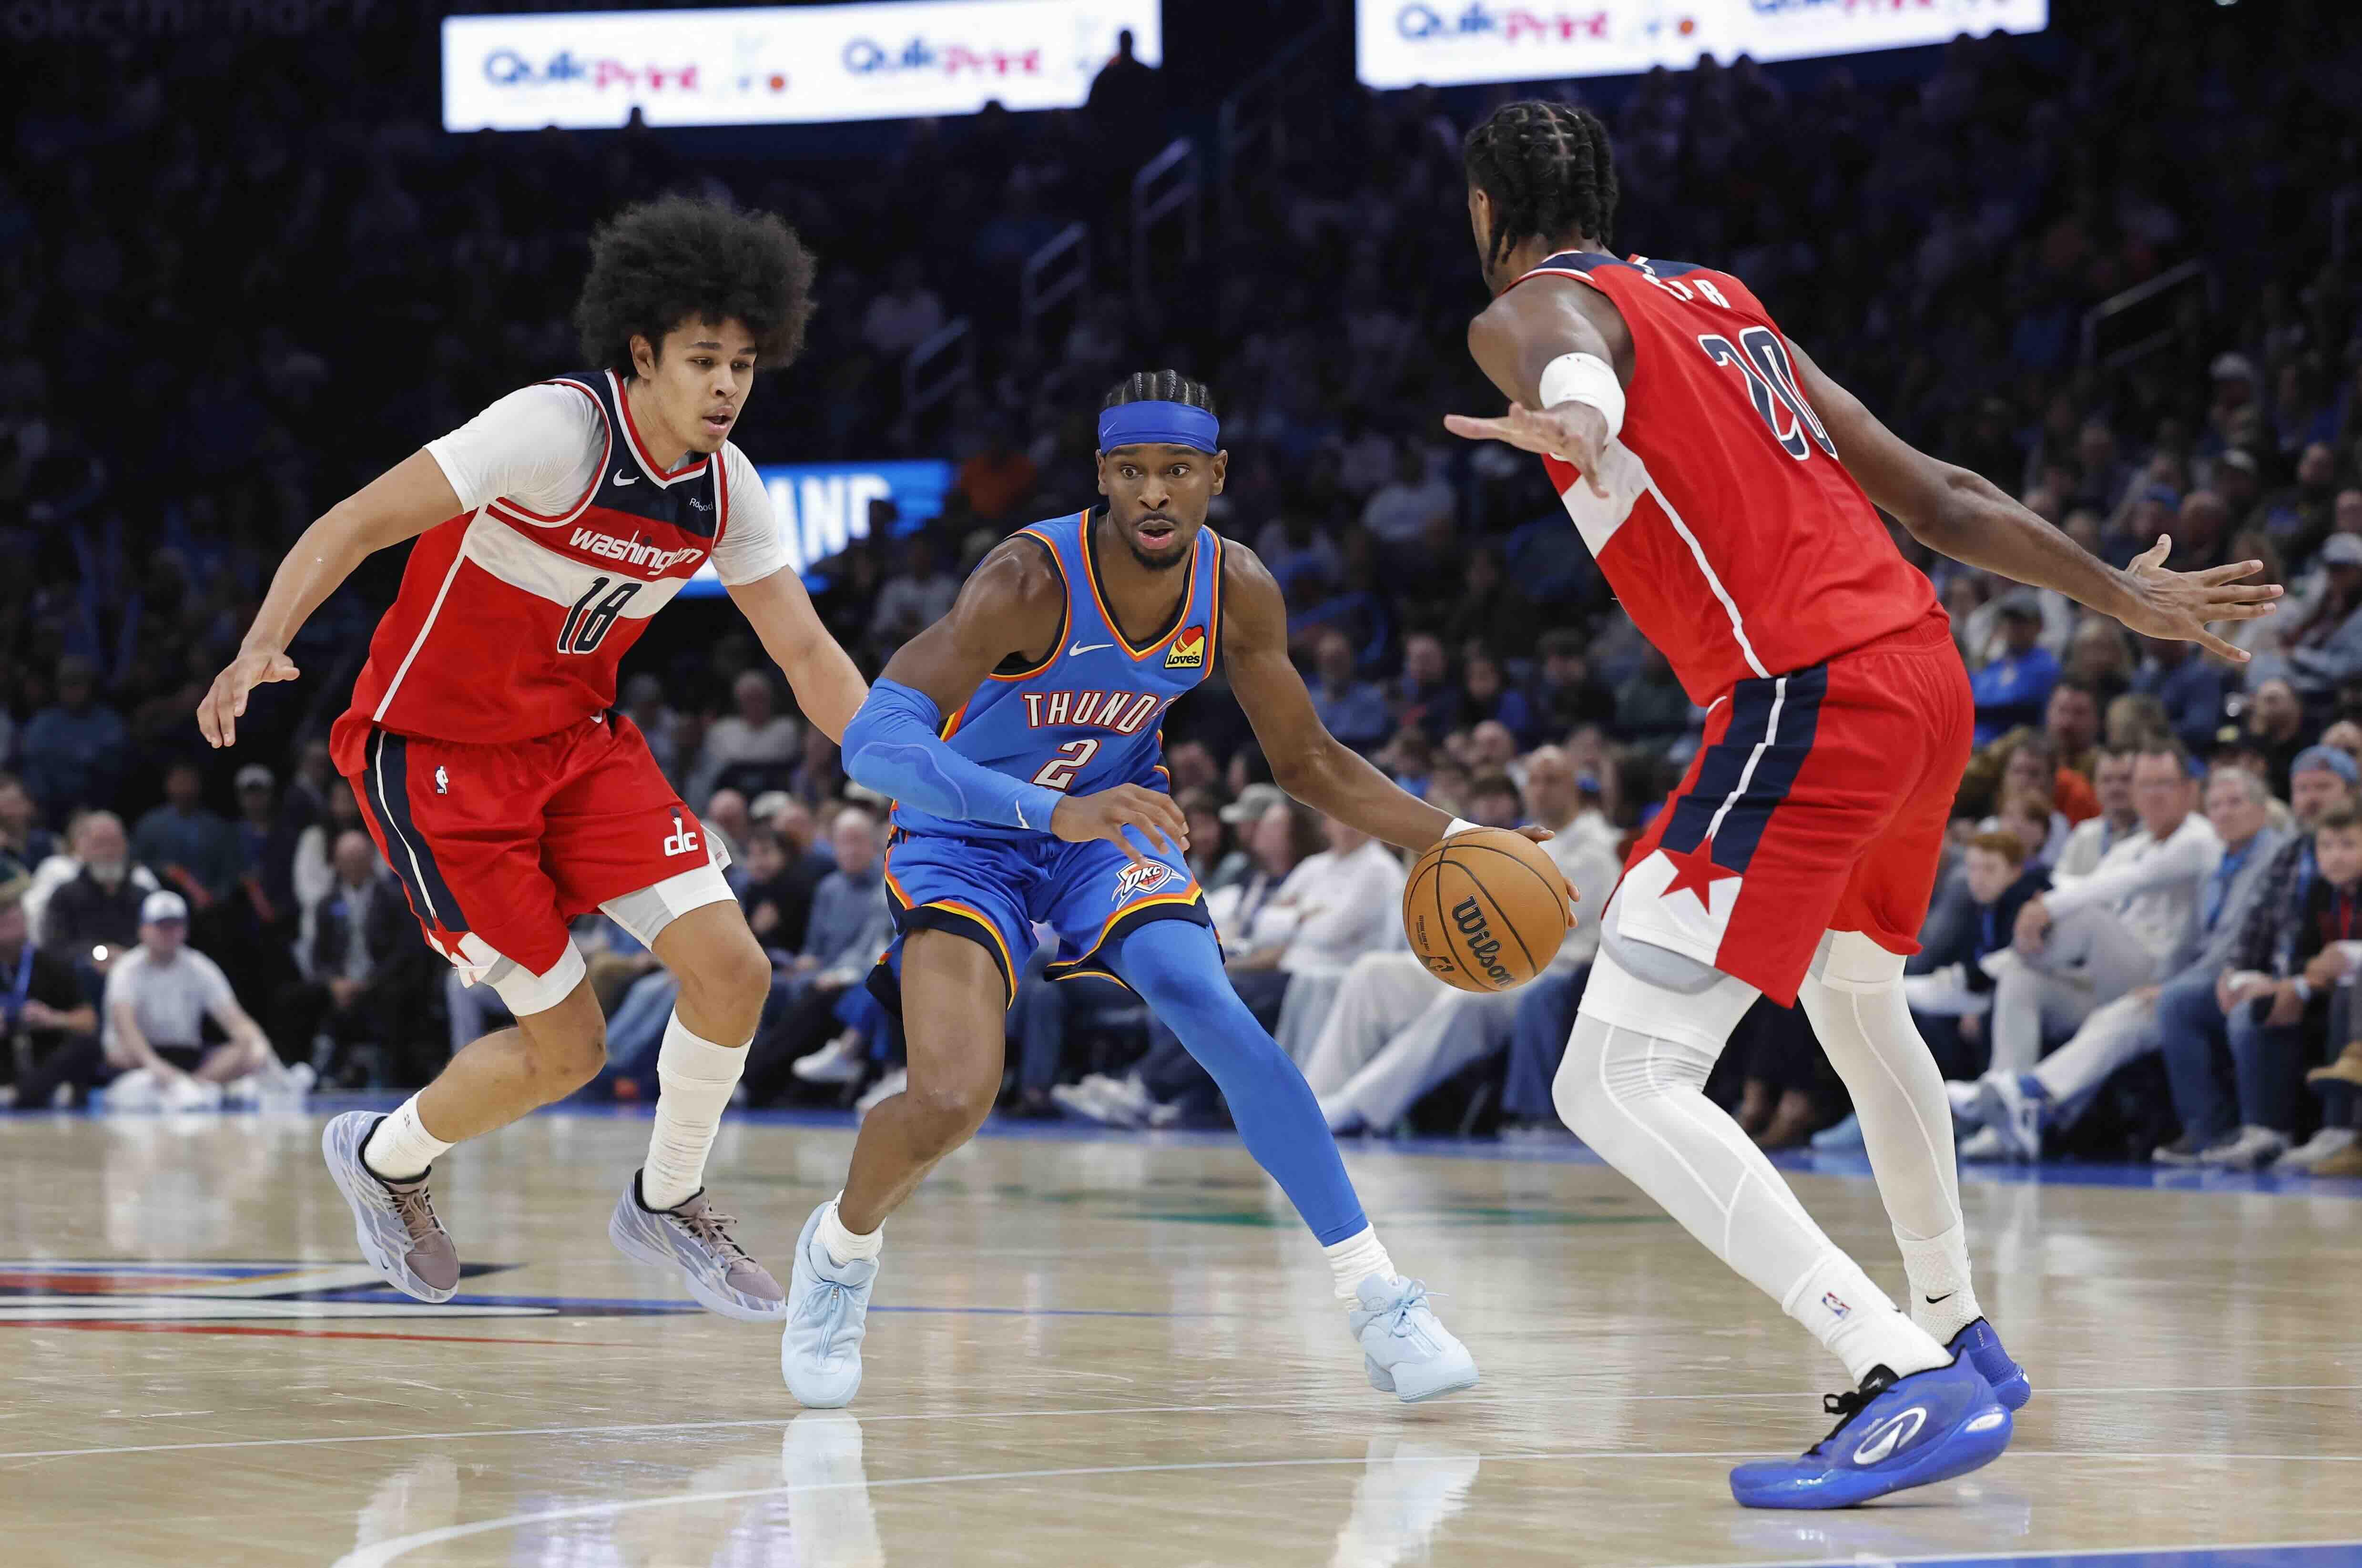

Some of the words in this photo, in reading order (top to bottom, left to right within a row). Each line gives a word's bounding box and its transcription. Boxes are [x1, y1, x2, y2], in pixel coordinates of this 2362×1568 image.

[1697, 326, 1839, 461] 20
[569, 527, 704, 576] washington
[557, 574, 644, 655] 18
[1029, 737, 1102, 791] 2
[1123, 866, 1162, 894] OKC
[1452, 893, 1517, 987] Wilson
